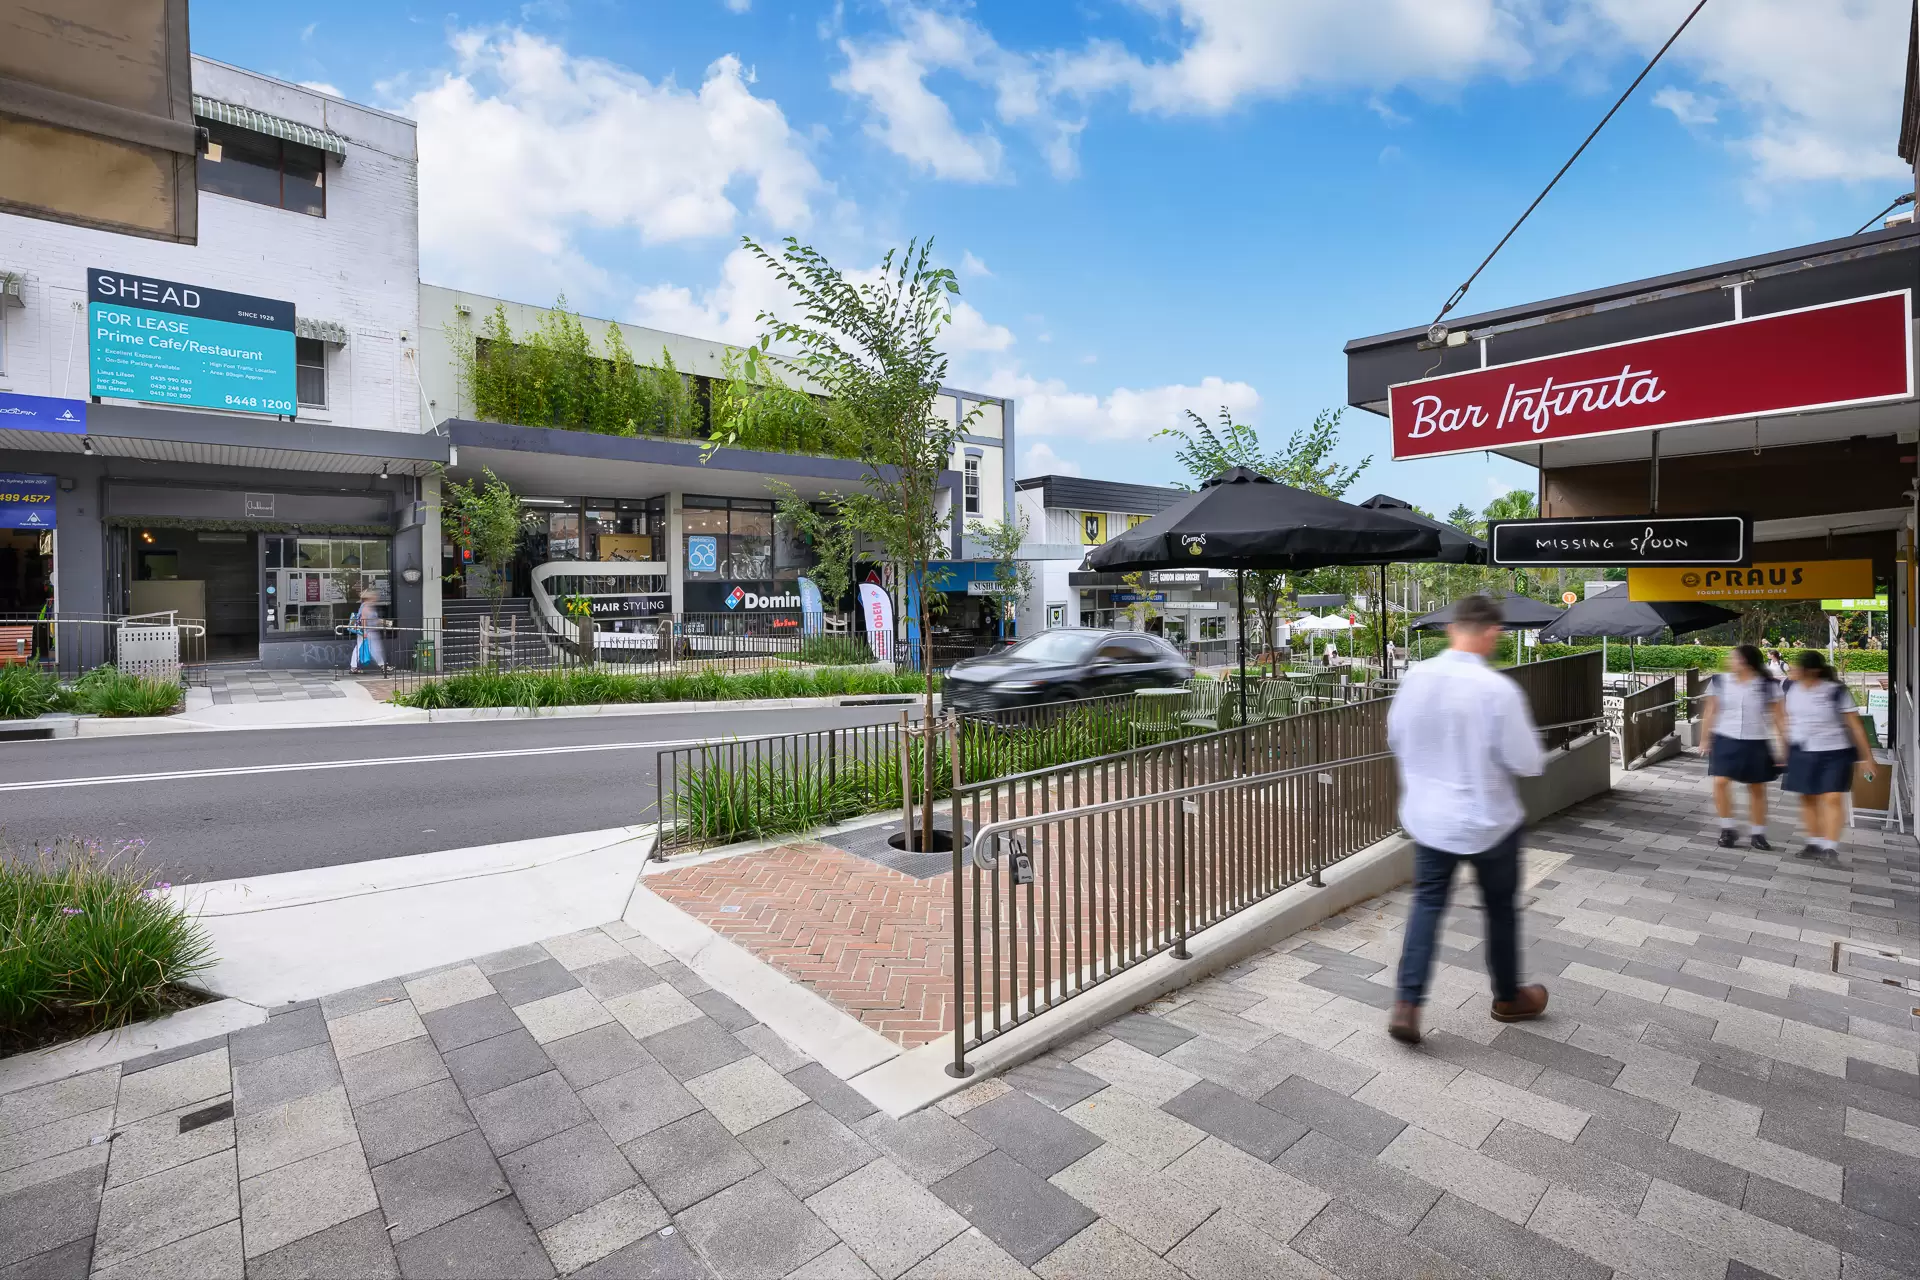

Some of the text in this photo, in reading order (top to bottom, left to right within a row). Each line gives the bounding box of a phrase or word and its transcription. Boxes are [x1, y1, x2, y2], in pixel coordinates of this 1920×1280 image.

[98, 276, 200, 308] SHEAD
[97, 310, 189, 335] FOR LEASE
[237, 310, 258, 319] SINCE
[97, 328, 263, 361] Prime Cafe/Restaurant
[225, 394, 292, 411] 8448 1200
[1408, 364, 1667, 439] Bar Infinita
[21, 494, 51, 503] 4577
[1536, 538, 1615, 549] MISSING
[974, 581, 993, 591] SUSHI
[1705, 567, 1804, 588] PRAUS
[592, 600, 665, 612] HAIR STYLING
[744, 590, 800, 609] Domin
